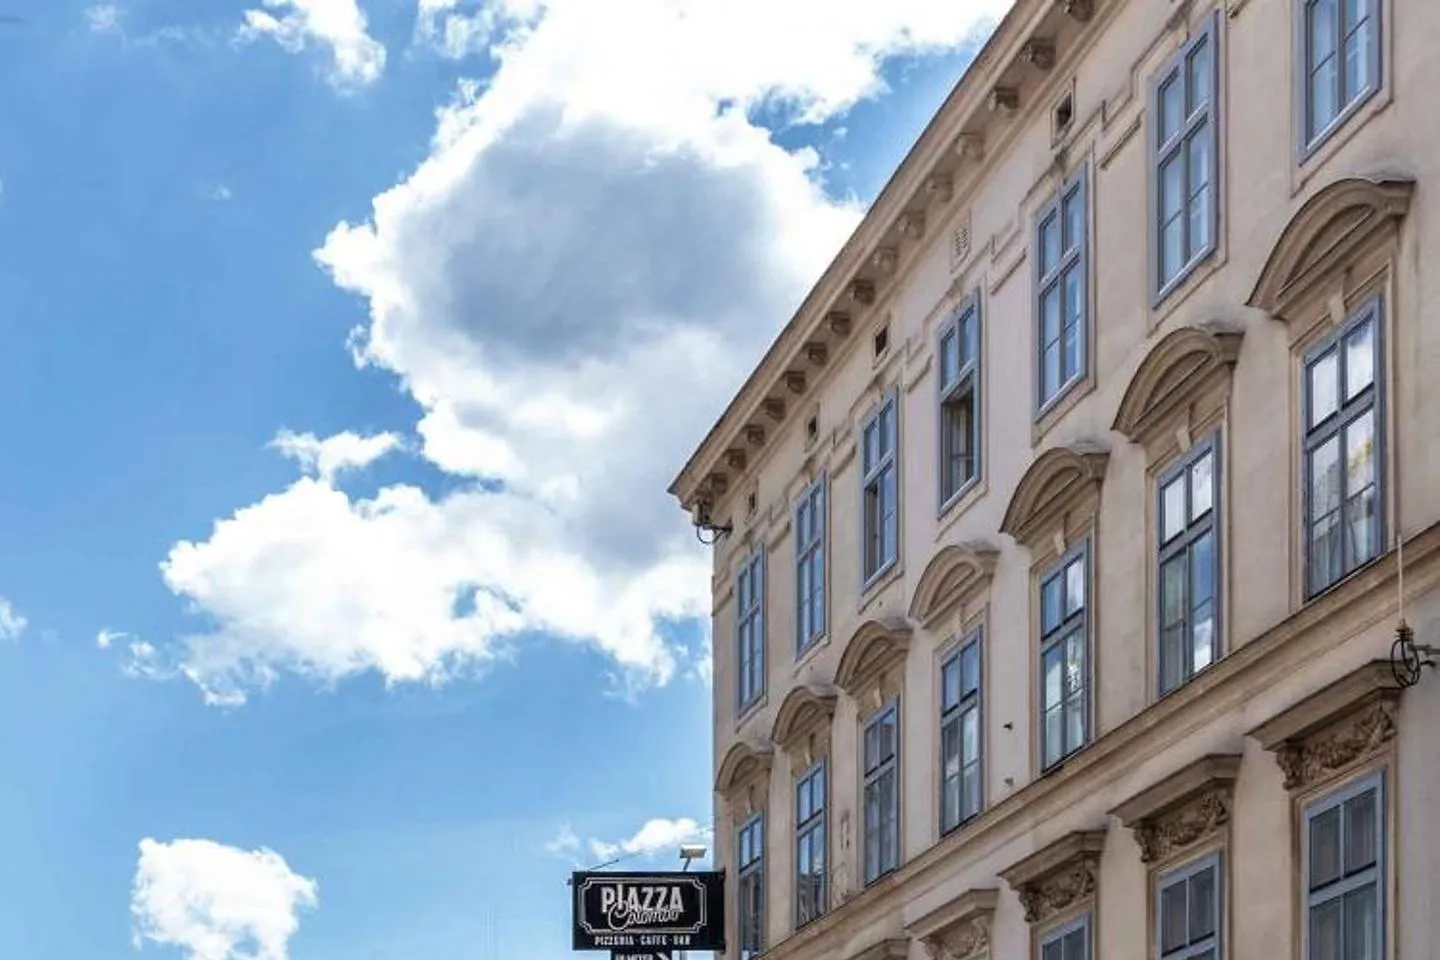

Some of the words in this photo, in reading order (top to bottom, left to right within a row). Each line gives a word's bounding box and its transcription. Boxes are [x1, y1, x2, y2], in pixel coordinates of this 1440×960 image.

[601, 883, 684, 914] PIAZZA
[594, 933, 635, 946] PIZZERIA
[673, 933, 691, 946] BAR
